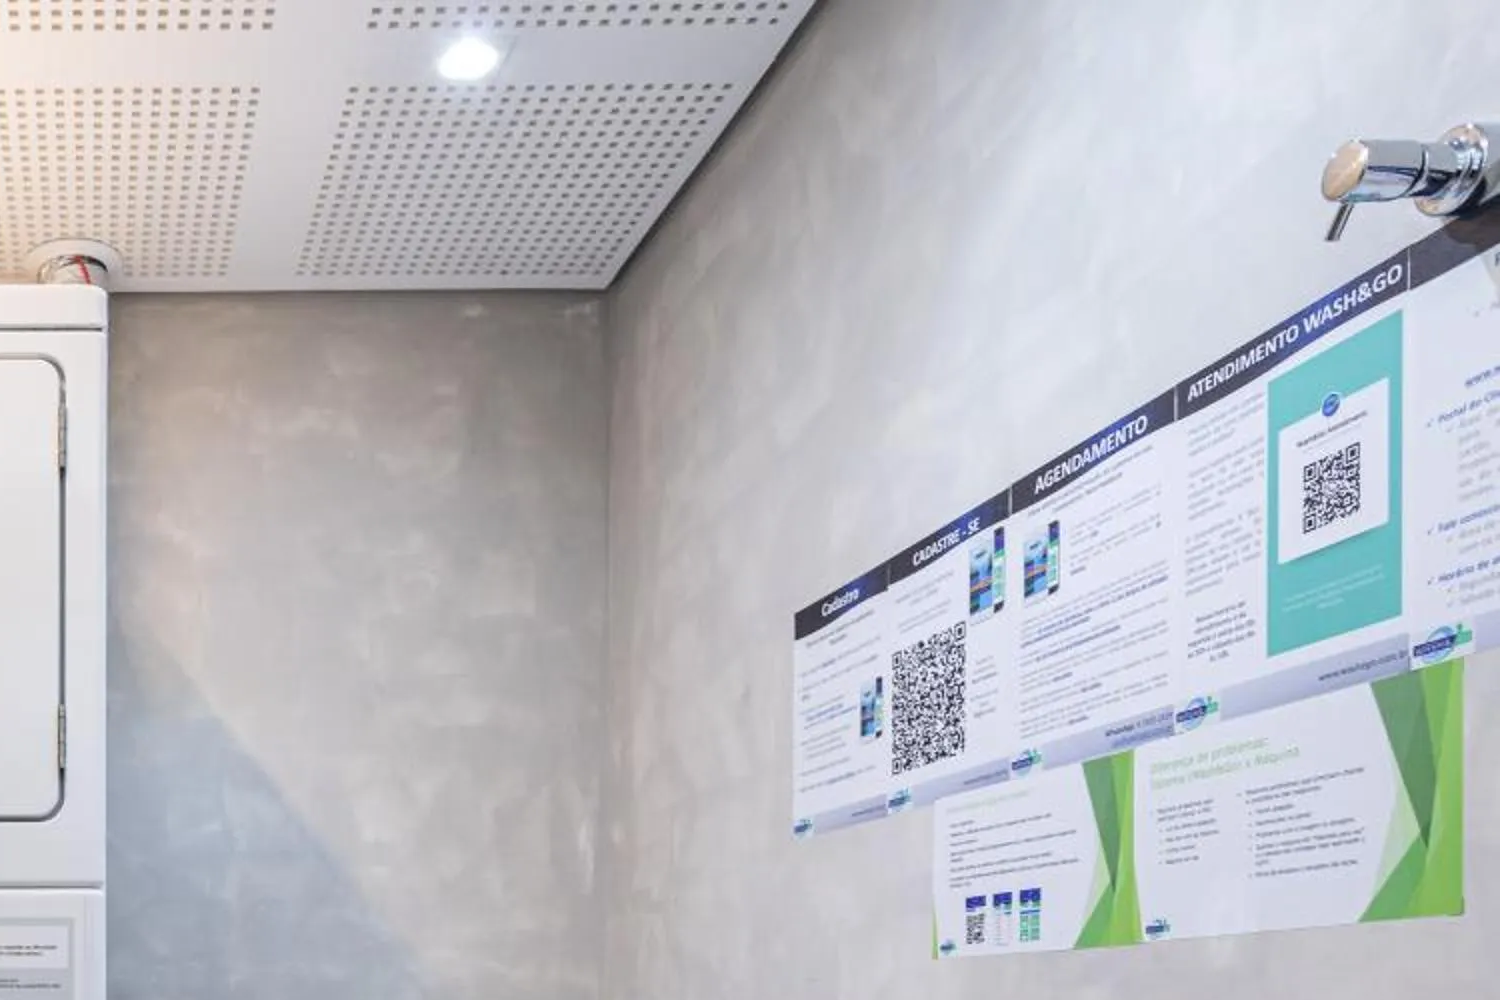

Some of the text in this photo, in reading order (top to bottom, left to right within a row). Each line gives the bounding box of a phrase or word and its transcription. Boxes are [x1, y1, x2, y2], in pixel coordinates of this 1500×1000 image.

[1187, 264, 1402, 402] ATENDIMENTO WASH&GO
[1033, 415, 1148, 495] AGENDAMENTO
[912, 528, 960, 566] CADASTRE
[967, 517, 981, 535] SE
[820, 588, 861, 617] Cadastro
